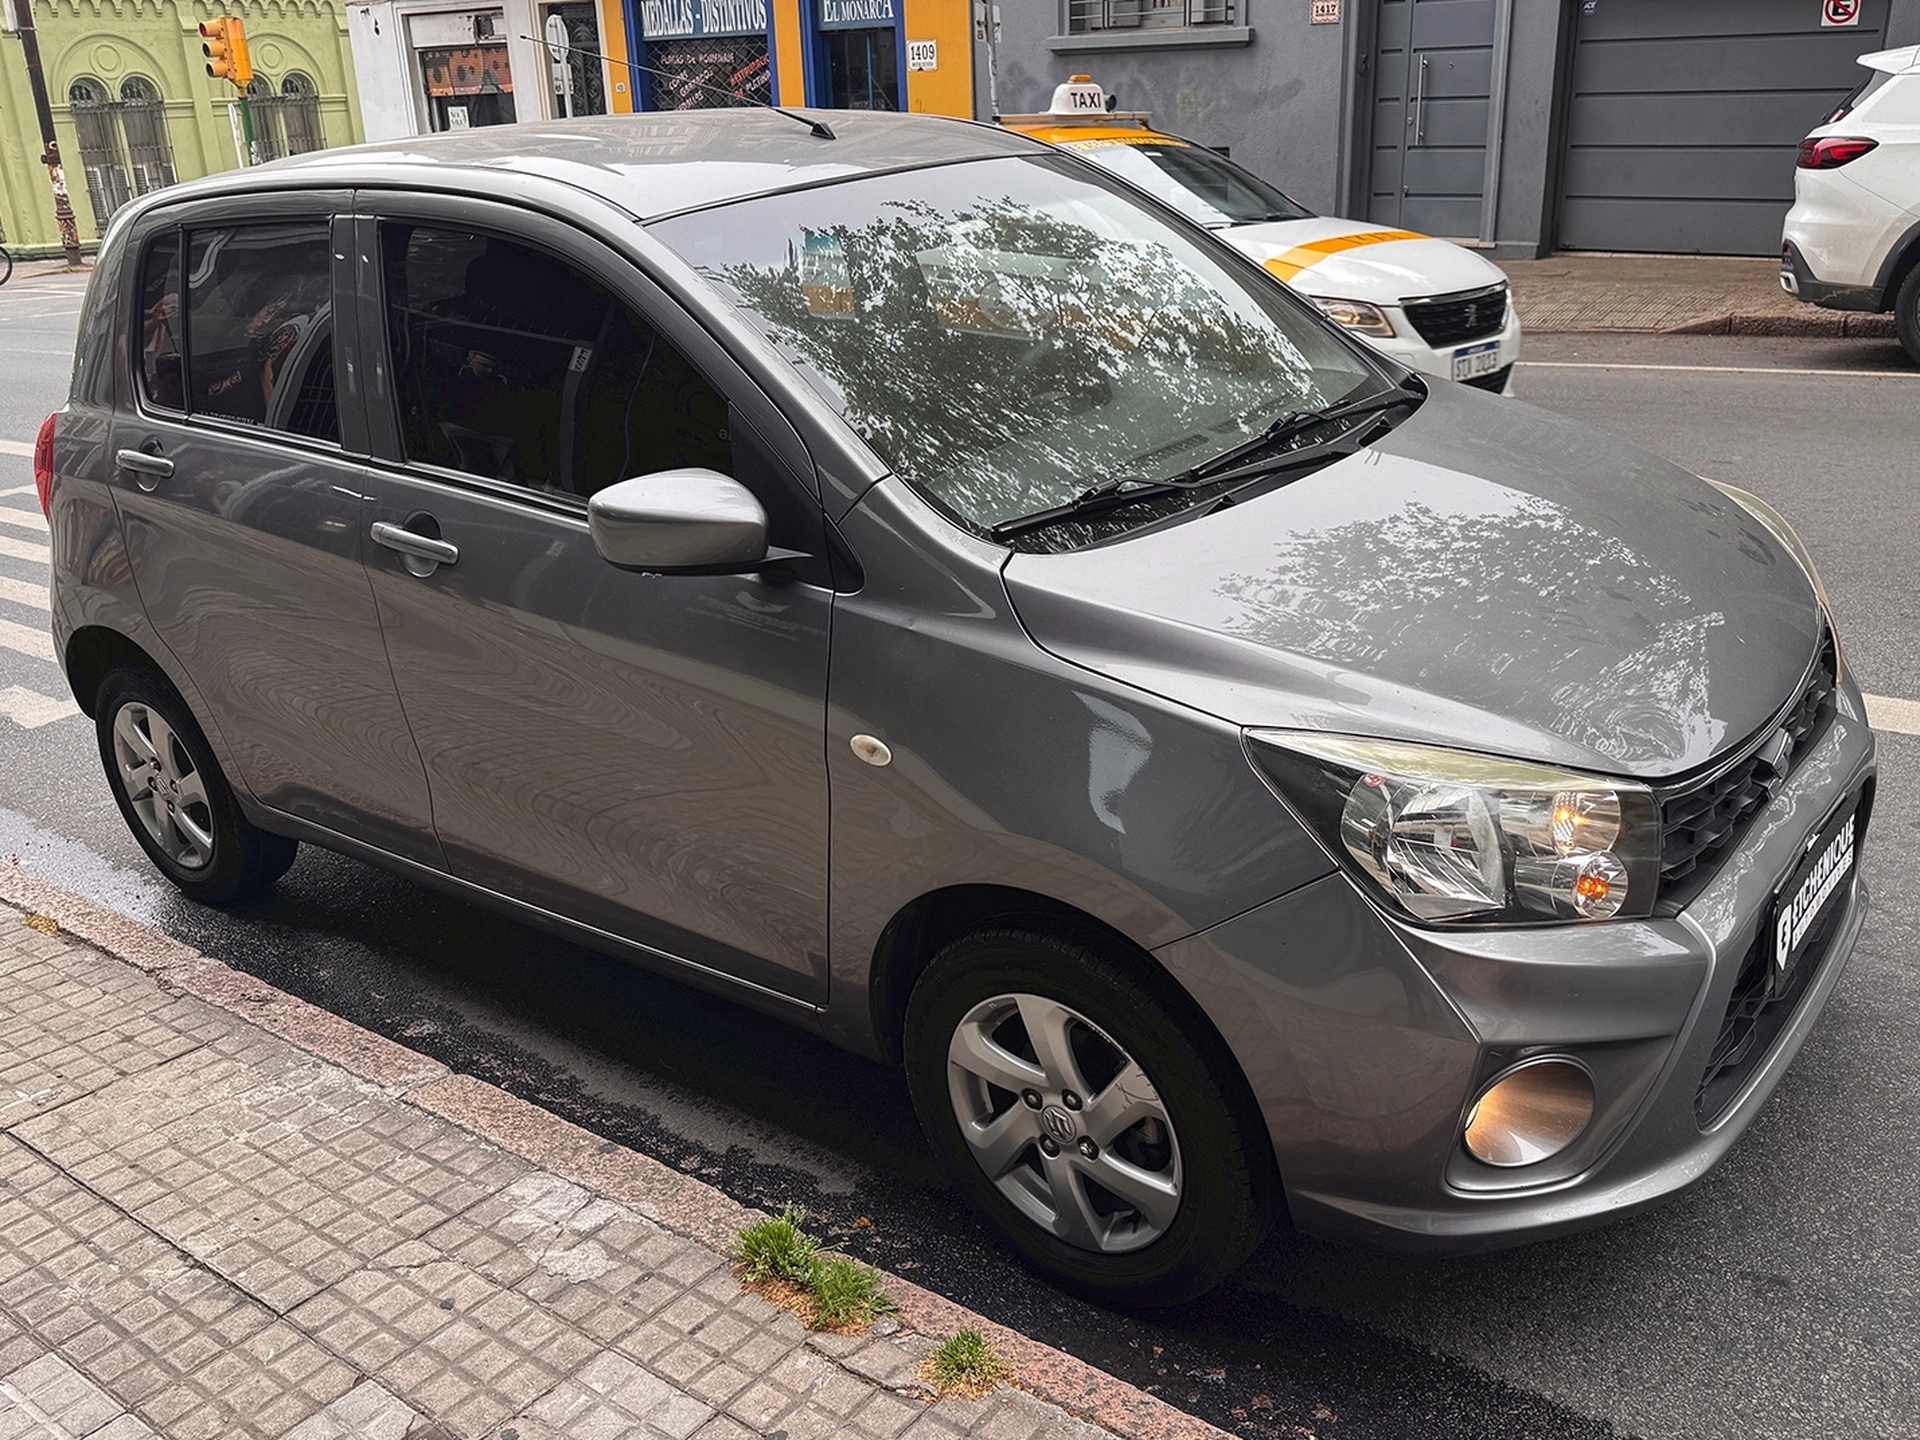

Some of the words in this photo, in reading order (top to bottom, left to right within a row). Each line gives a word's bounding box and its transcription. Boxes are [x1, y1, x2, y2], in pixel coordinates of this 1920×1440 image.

[824, 0, 839, 22] EL
[841, 0, 894, 20] MONARCA
[1316, 4, 1337, 13] 1417
[641, 0, 693, 37] MEDALLAS
[701, 0, 767, 34] DISTINTIVOS
[911, 44, 935, 61] 1409
[1070, 92, 1101, 109] TAXI
[1792, 813, 1854, 929] ETCHENIQUE
